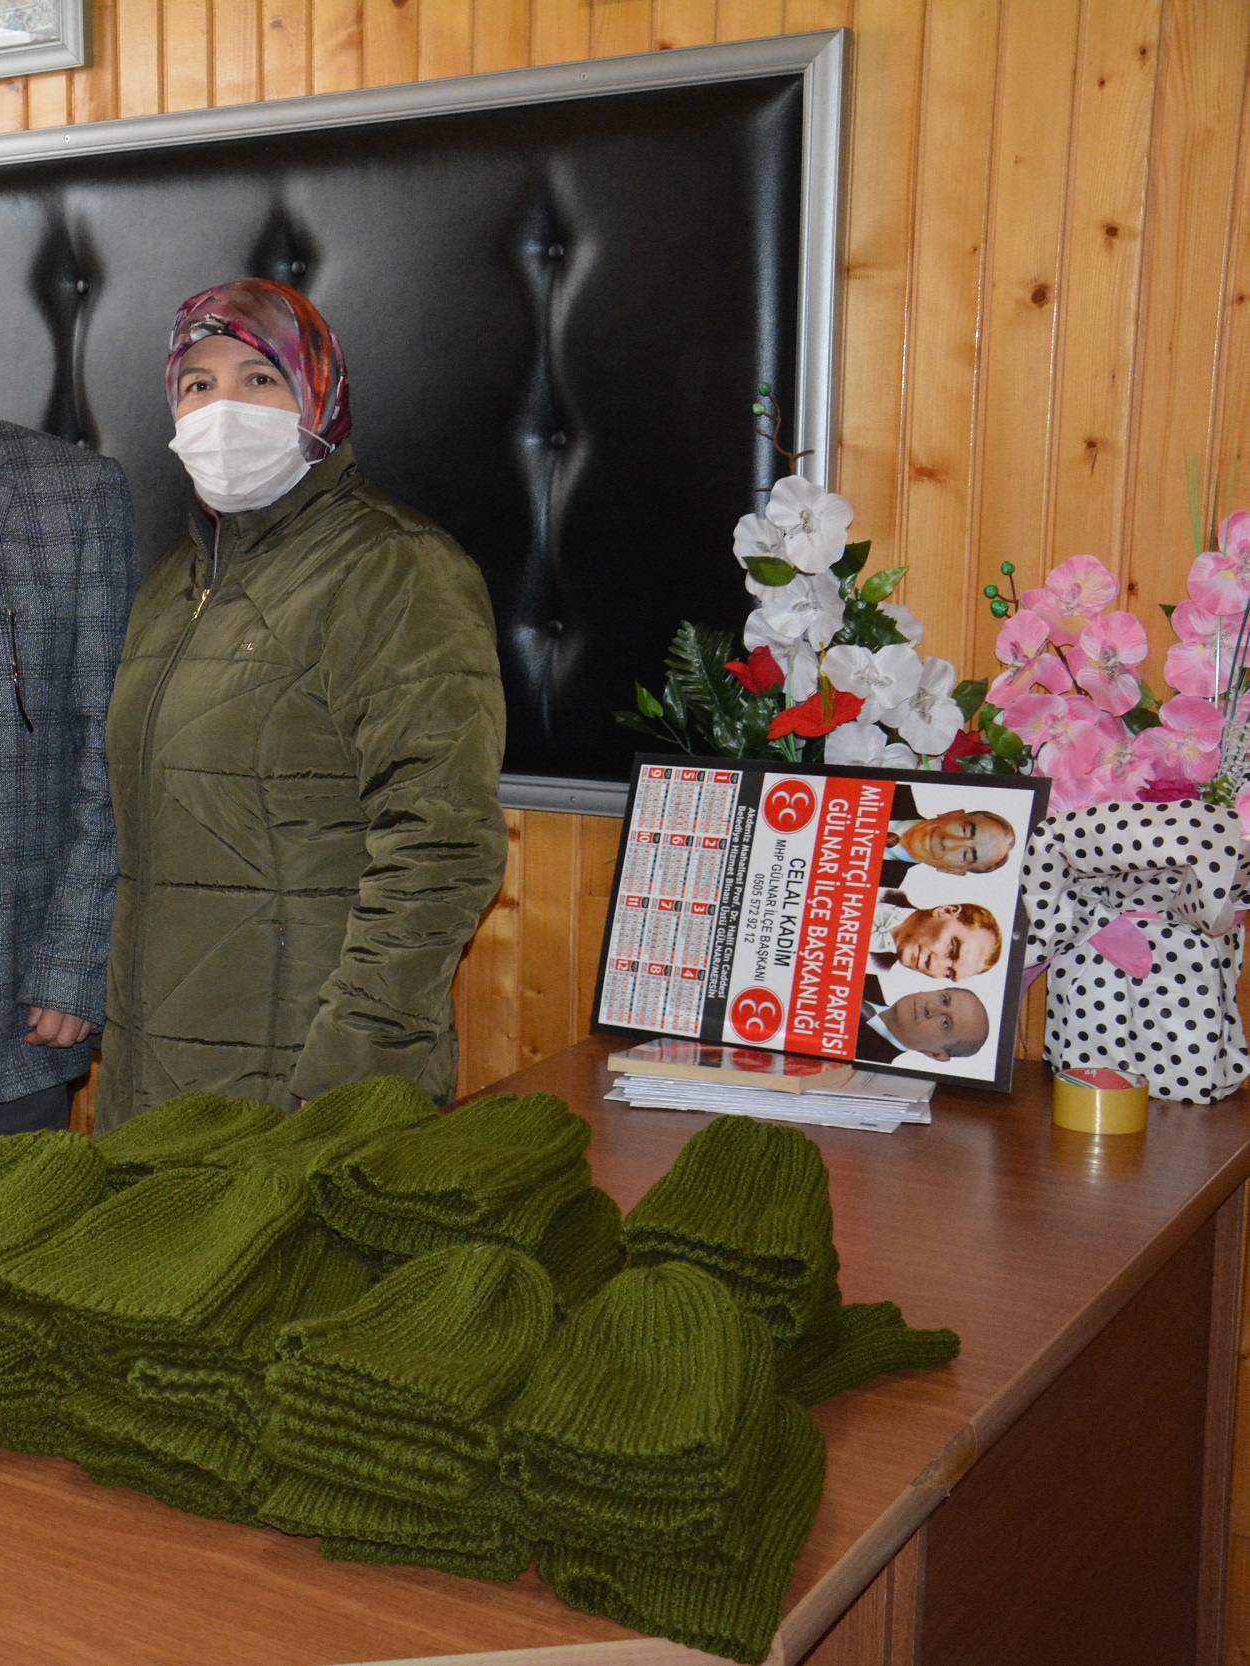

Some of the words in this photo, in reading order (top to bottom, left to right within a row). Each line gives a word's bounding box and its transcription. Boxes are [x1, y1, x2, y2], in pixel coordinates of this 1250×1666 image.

[732, 805, 747, 843] Belediye
[742, 807, 756, 842] Akdeniz
[817, 798, 851, 874] GÜLNAR
[842, 785, 884, 888] MİLLİYETÇİ
[727, 844, 739, 875] Hizmet
[735, 844, 750, 884] Mahallesi
[774, 839, 787, 861] MHP
[722, 877, 733, 904] Binası
[731, 886, 743, 907] Prof.
[751, 873, 765, 896] 0505
[765, 864, 783, 906] GÜLNAR
[782, 858, 806, 910] CELAL
[807, 880, 840, 920] İLÇE
[729, 910, 739, 922] Dr.
[745, 917, 758, 930] 92
[748, 898, 761, 916] 572
[760, 908, 778, 933] İLÇE
[744, 932, 756, 944] 12
[774, 914, 797, 967] KADİM
[832, 893, 864, 981] HAREKET
[754, 935, 771, 982] BAŞKANI
[718, 964, 730, 998] Caddesi
[793, 925, 828, 1035] BAŞKANLIĞI
[822, 985, 850, 1055] PARTİSİ
